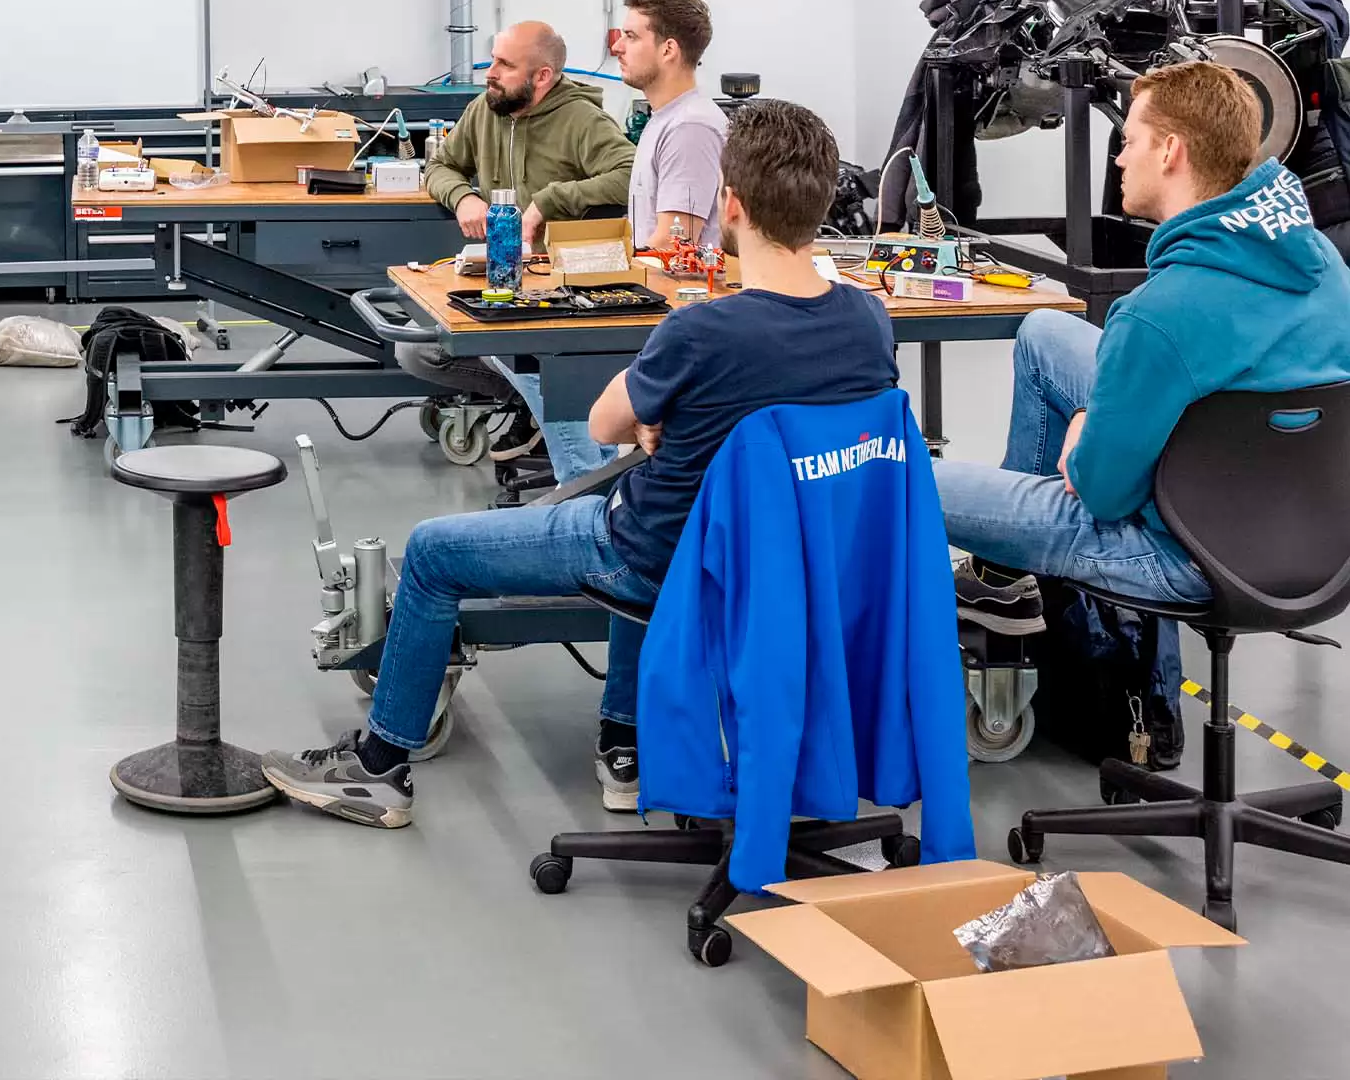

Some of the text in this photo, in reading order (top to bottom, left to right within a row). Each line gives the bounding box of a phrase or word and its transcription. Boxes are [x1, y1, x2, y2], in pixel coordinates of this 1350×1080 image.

[1245, 169, 1301, 205] THE
[1260, 205, 1314, 241] FAC
[791, 449, 841, 481] TEAM
